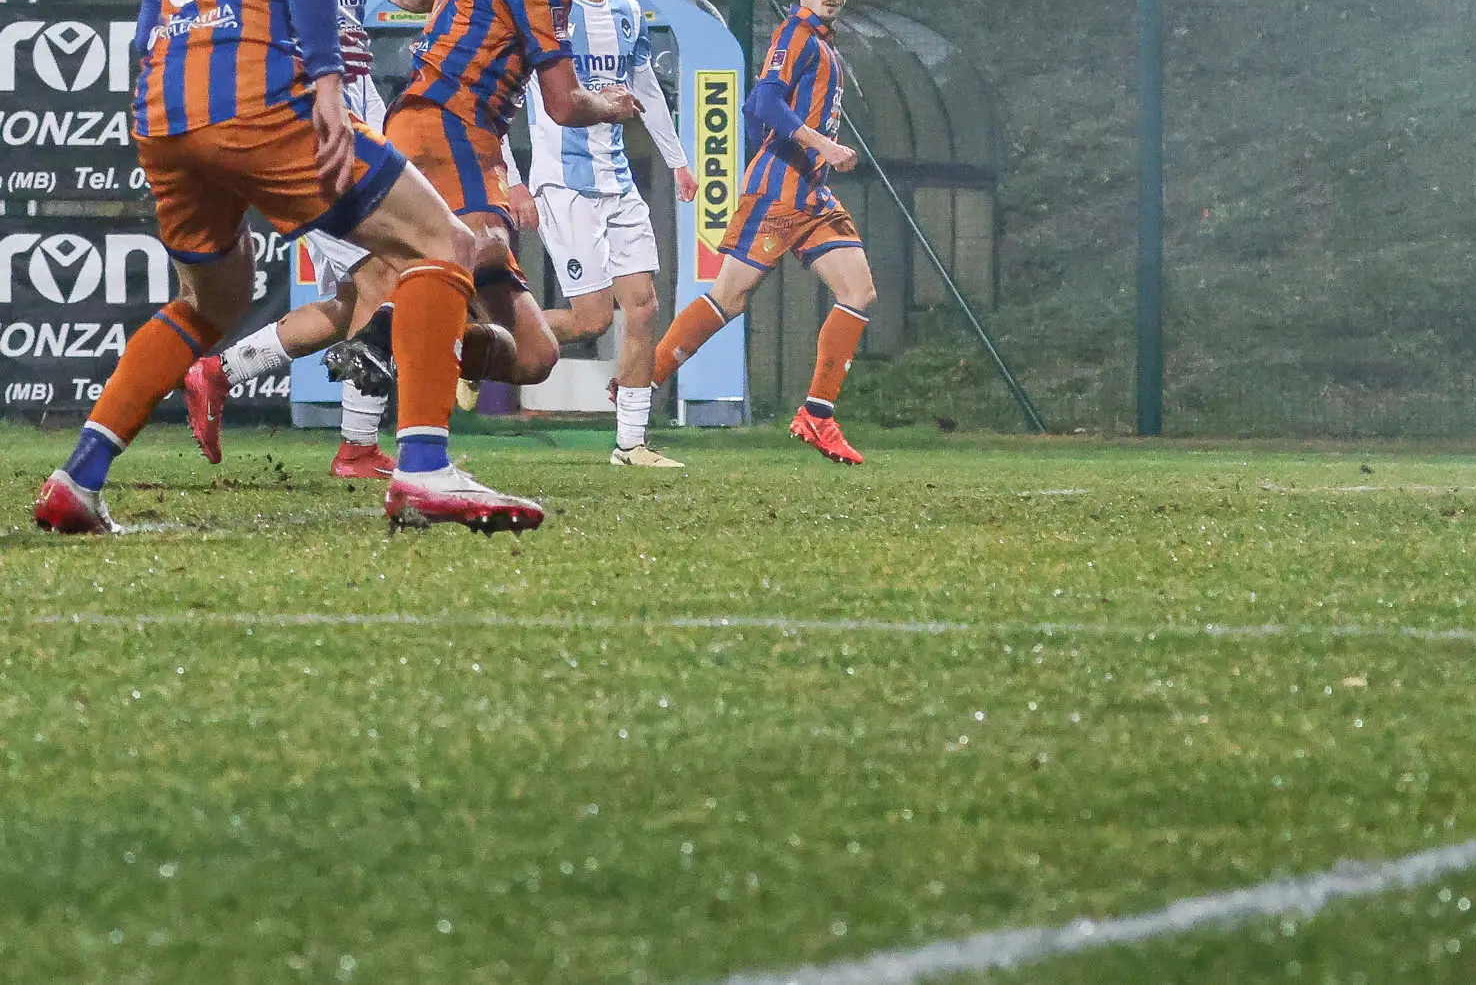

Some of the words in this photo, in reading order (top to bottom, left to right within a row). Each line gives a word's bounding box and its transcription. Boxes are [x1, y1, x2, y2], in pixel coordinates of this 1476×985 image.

[0, 110, 129, 147] ONZA
[704, 81, 729, 230] KOPRON
[8, 171, 57, 193] (MB)
[74, 166, 120, 190] Tel.
[128, 166, 151, 190] 0
[0, 321, 126, 358] ONZA
[4, 382, 54, 404] (MB)
[72, 378, 108, 401] Te
